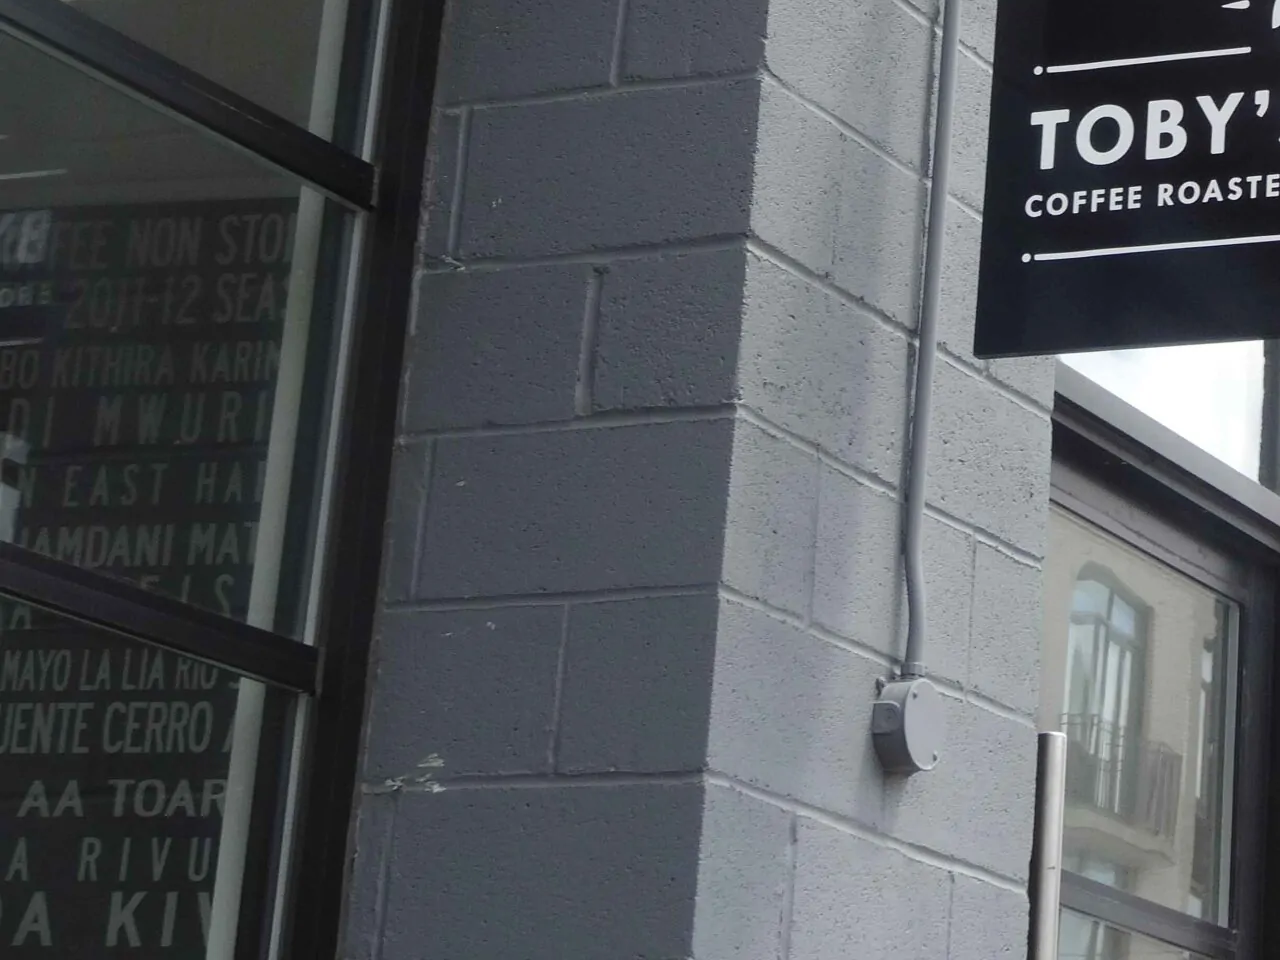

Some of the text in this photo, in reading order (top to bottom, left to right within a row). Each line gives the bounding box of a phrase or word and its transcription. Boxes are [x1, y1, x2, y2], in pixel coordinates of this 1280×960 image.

[1025, 186, 1142, 217] COFFEE
[125, 215, 202, 268] NON
[213, 272, 291, 324] SEA
[62, 463, 168, 507] EAST
[0, 649, 72, 691] MAYO
[79, 649, 111, 691] LA
[121, 648, 165, 691] LIA
[102, 701, 213, 754] CERRO
[16, 779, 84, 818] AA
[0, 891, 53, 947] A
